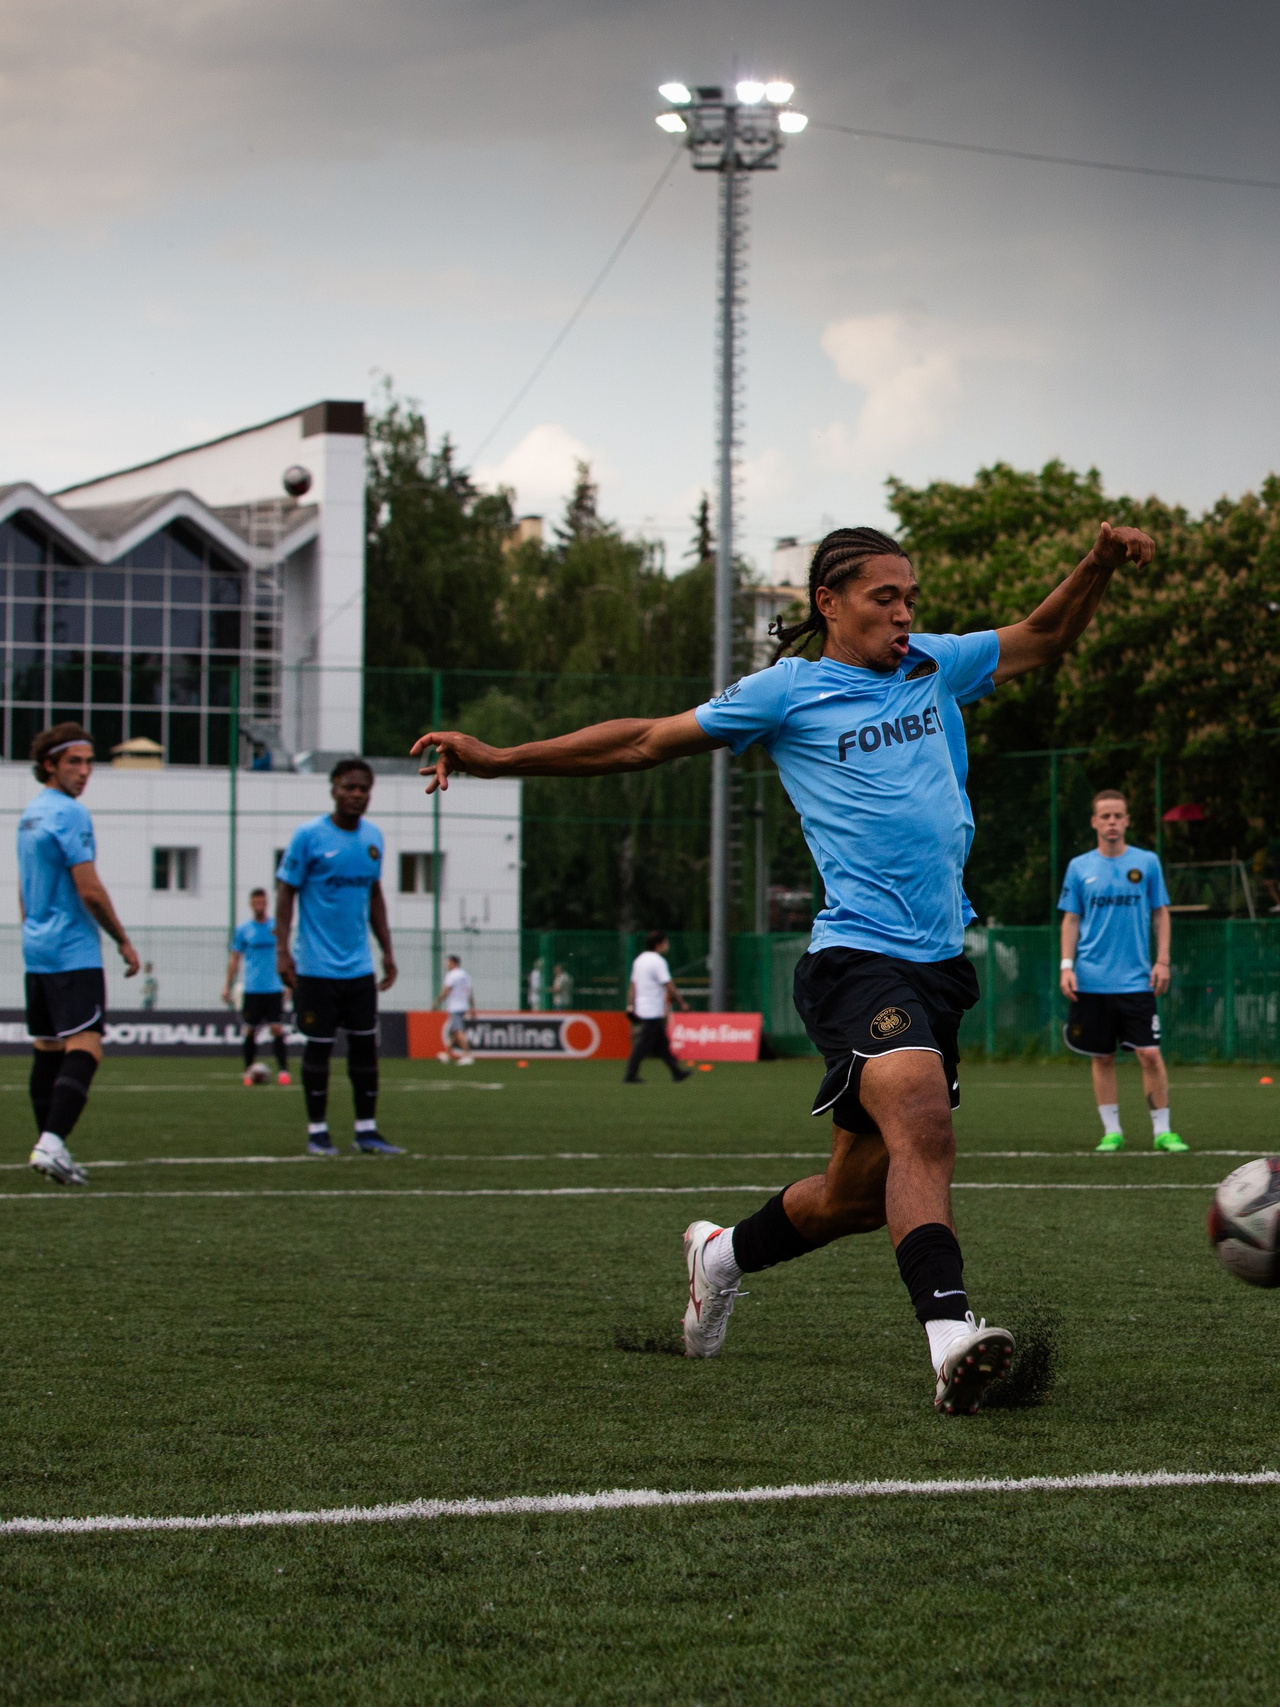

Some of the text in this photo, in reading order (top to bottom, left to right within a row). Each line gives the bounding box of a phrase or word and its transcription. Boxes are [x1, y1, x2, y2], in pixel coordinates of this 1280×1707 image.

[838, 705, 944, 763] FONBET
[1090, 894, 1142, 909] FONBET
[101, 1022, 223, 1044] OTBALL
[465, 1023, 556, 1047] Winline
